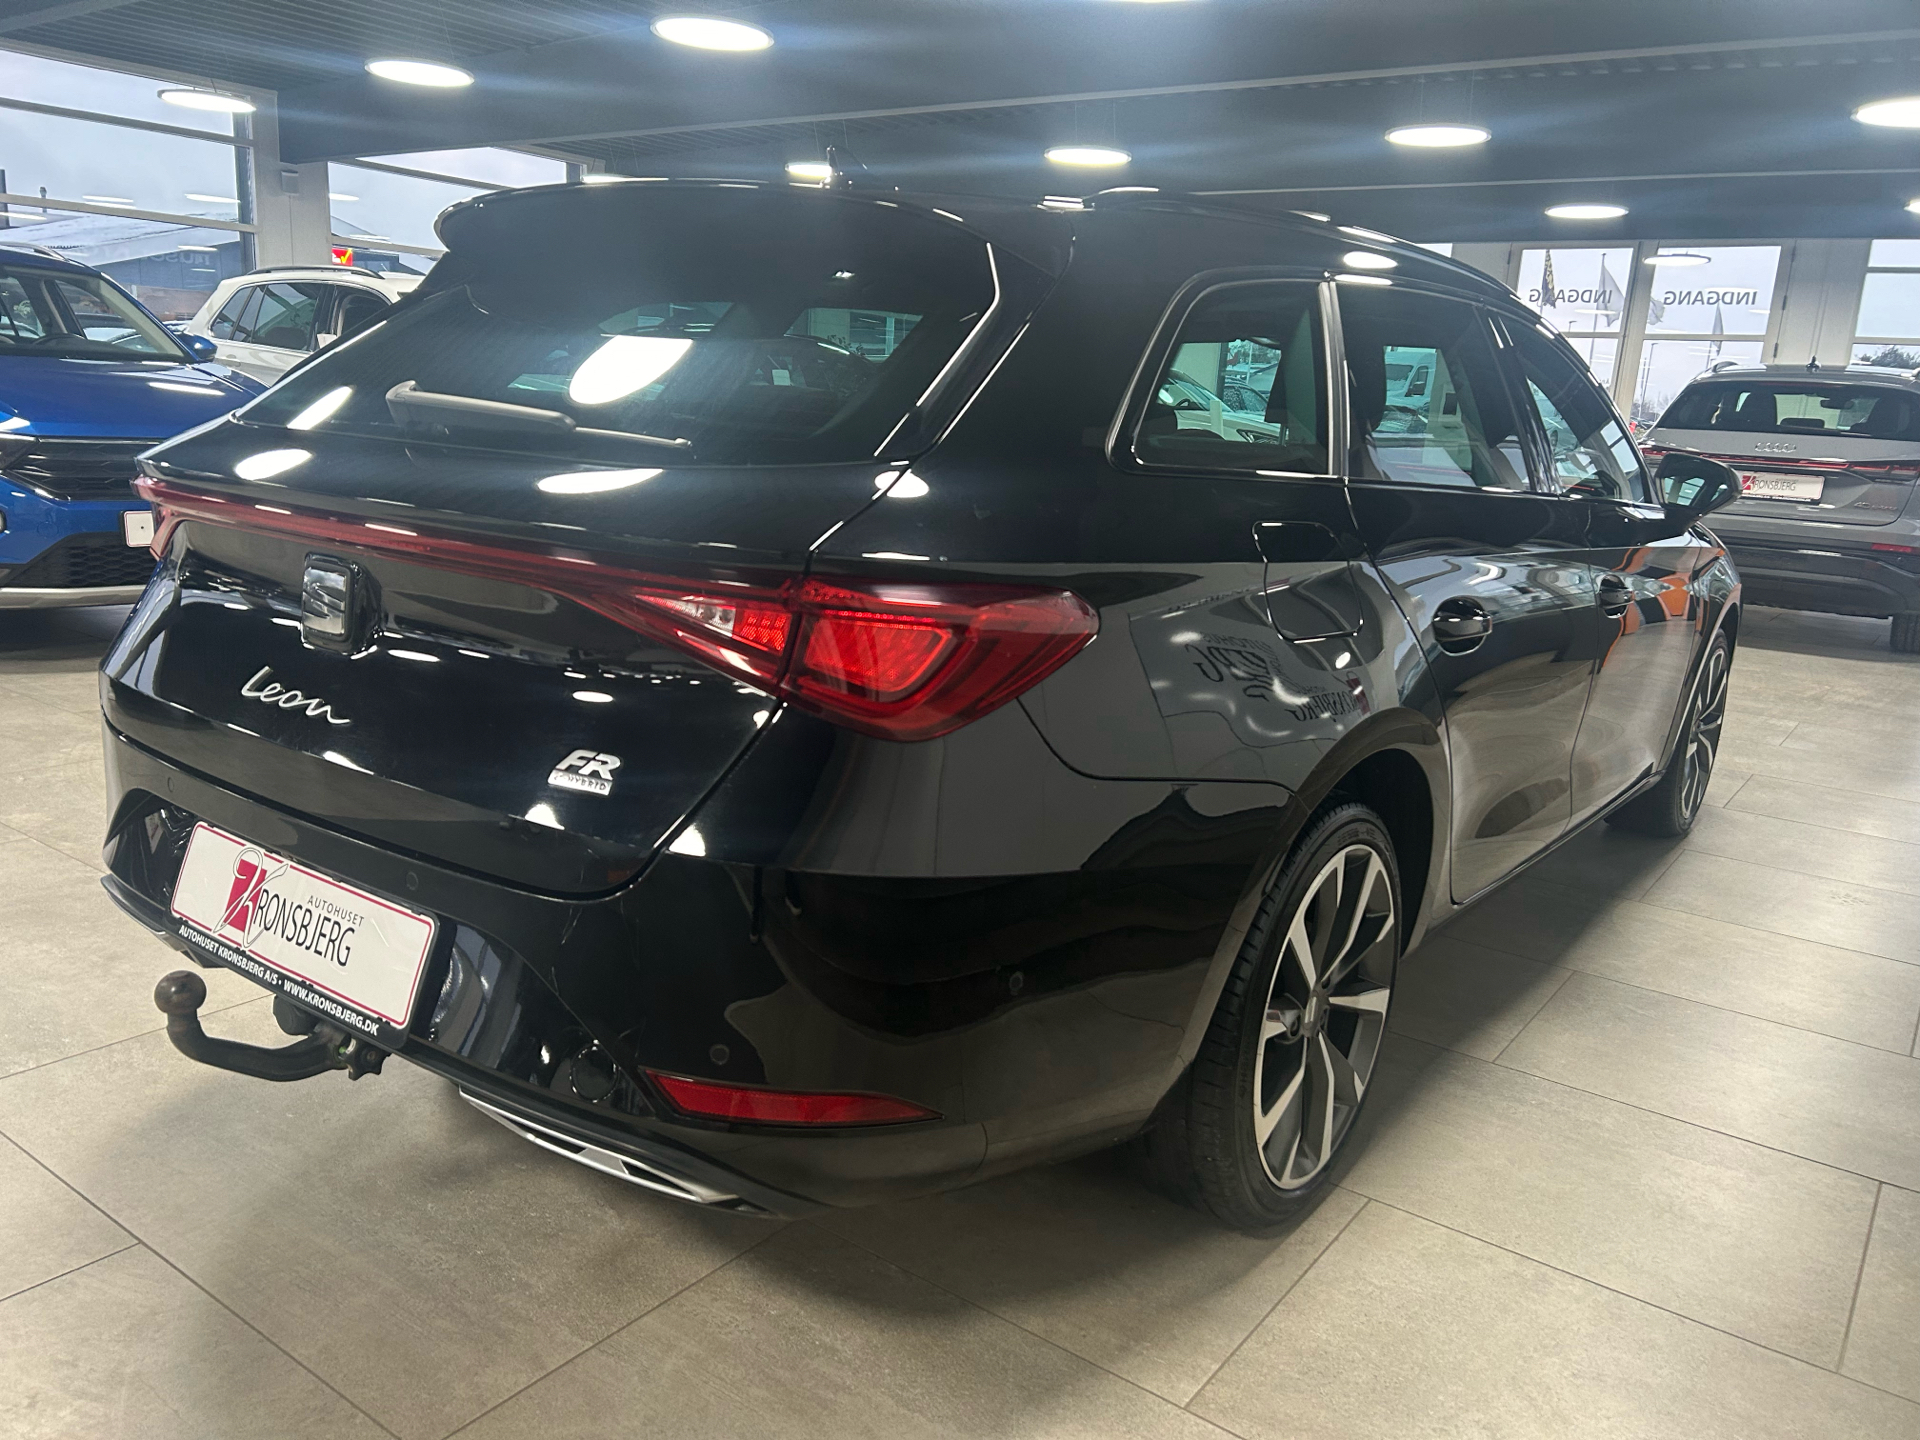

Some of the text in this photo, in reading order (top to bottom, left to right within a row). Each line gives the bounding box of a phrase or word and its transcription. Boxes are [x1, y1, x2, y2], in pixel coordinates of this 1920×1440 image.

[241, 666, 351, 724] Leon
[555, 749, 621, 781] FR
[306, 895, 365, 928] AUTOHUSET
[178, 924, 380, 1036] AUTOHUSET KRONSBJERG A/S WWW.KRONSBJERG.DK
